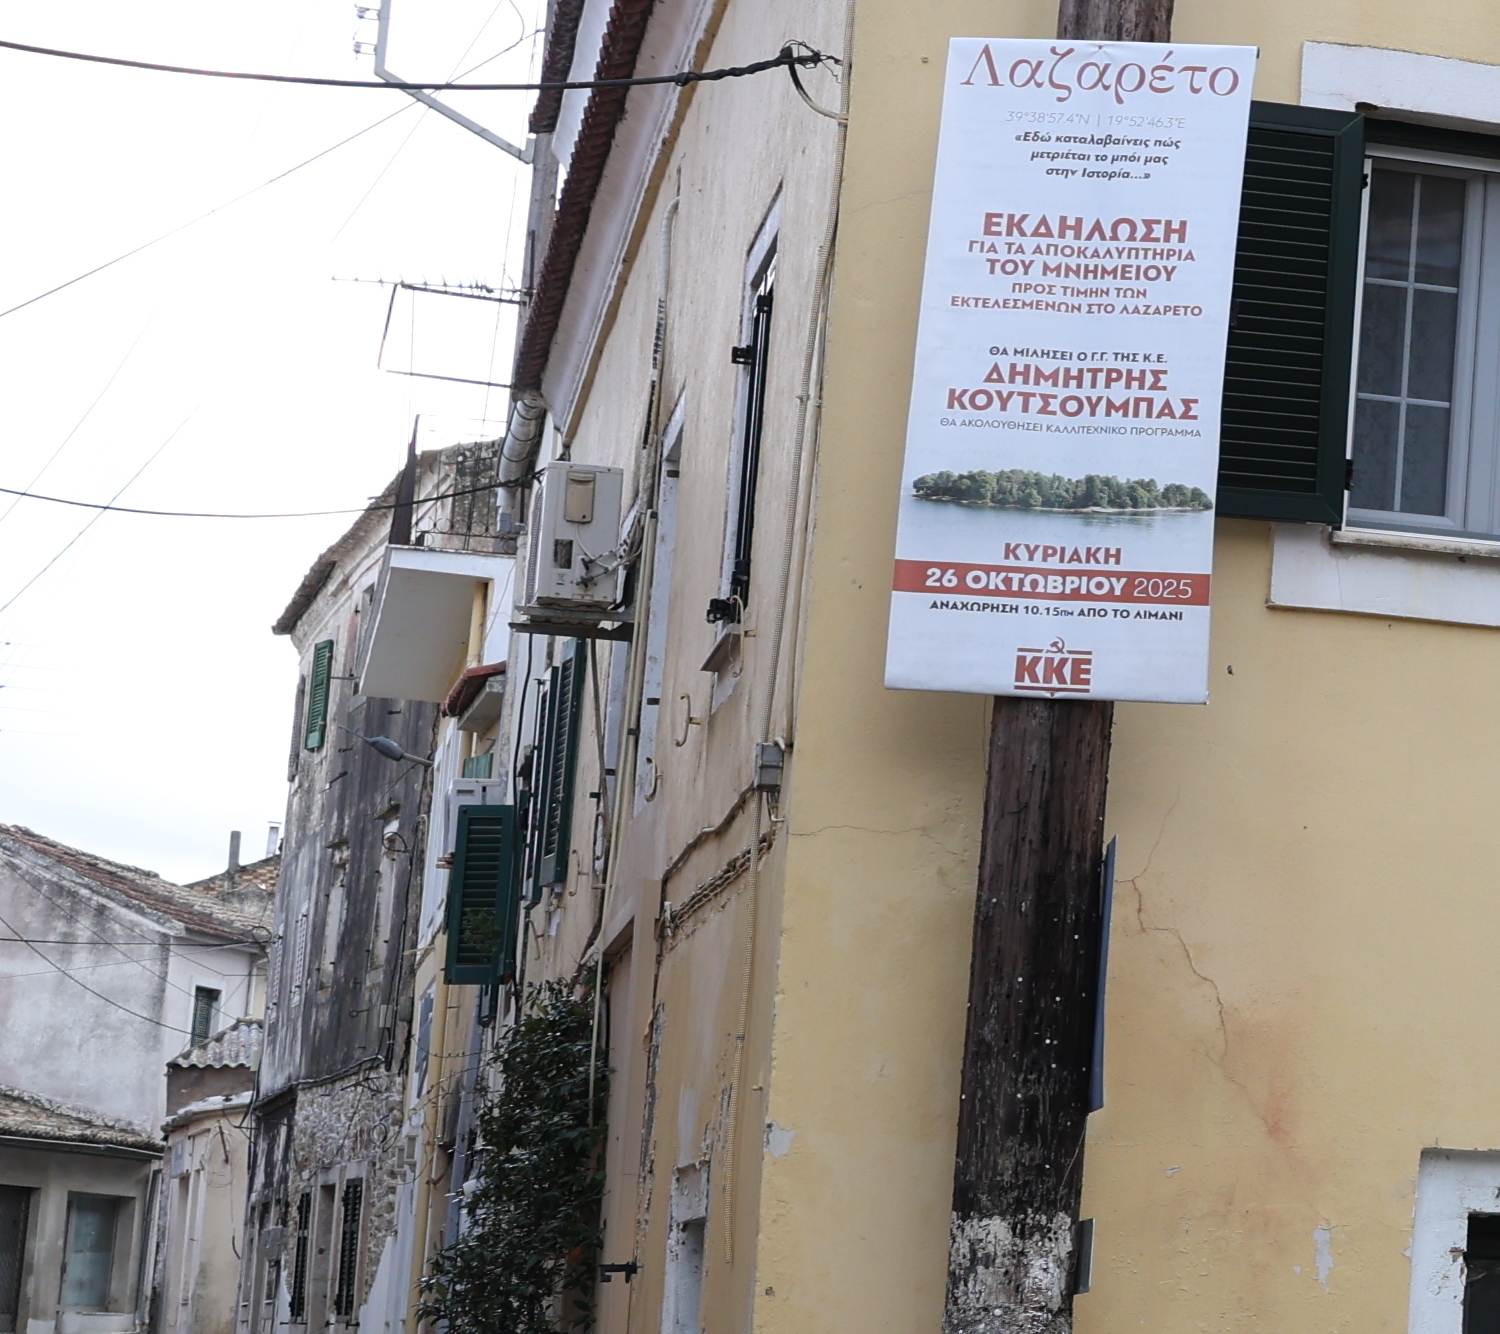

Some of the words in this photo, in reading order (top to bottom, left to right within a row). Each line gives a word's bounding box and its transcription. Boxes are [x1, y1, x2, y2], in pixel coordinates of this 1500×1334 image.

[959, 43, 1240, 106] Λαζαρέτο
[1014, 130, 1052, 143] «Εδώ
[1054, 133, 1151, 149] καταλαβαίνεις
[1153, 137, 1182, 150] πώς
[1029, 149, 1091, 162] μετριέται
[1094, 153, 1108, 162] το
[1110, 152, 1141, 165] μπόι
[1143, 154, 1170, 166] μας
[1045, 167, 1078, 179] στην
[983, 211, 1188, 244] ΕΚΔΗΛΩΣΗ
[968, 239, 999, 255] ΓΙΑ
[1003, 241, 1027, 256] ΤΑ
[1030, 241, 1196, 262] ΑΠΟΚΑΛΥΠΤΗΡΙΑ
[985, 258, 1035, 277] ΤΟΥ
[1041, 260, 1178, 283] ΜΝΗΜΕΙΟΥ
[1011, 282, 1057, 296] ΠΡΟΣ
[1060, 284, 1111, 299] ΤΙΜΗΝ
[1114, 286, 1148, 300] ΤΩΝ
[950, 295, 1082, 314] ΕΚΤΕΛΕΣΜΕΝΩΝ
[1085, 302, 1116, 315] ΣΤΟ
[1119, 303, 1203, 318] ΛΑΖΑΡΕΤΟ
[988, 346, 1010, 357] ΘΑ
[1012, 347, 1074, 362] ΜΙΛΗΣΕΙ
[1077, 350, 1088, 362] Ο
[1091, 350, 1109, 363] Γ.Γ.
[1112, 351, 1140, 364] ΤΗΣ
[1143, 352, 1168, 364] Κ.Ε.
[983, 361, 1169, 392] ΔΗΜΗΤΡΗΣ
[945, 387, 1200, 421] ΚΟΥΤΣΟΥΜΠΑΣ
[940, 416, 958, 428] ΘΑ
[959, 417, 1044, 433] ΑΚΟΛΟΥΘΗΣΕΙ
[1046, 423, 1128, 436] ΚΑΛΛΙΤΕΧΝΙΚΟ
[1130, 425, 1202, 438] ΠΡΟΓΡΑΜΜΑ
[1003, 542, 1122, 566] ΚΥΡΙΑΚΗ
[924, 567, 959, 588] 26
[965, 568, 1128, 596] ΟΚΤΩΒΡΙΟΥ
[1133, 577, 1193, 599] 2025
[929, 599, 1019, 615] ΑΝΑΧΩΡΗΣΗ
[1077, 607, 1108, 618] ΑΠΟ
[1111, 608, 1131, 619] ΤΟ
[1133, 609, 1184, 621] ΛΙΜΑΝΙ
[1014, 654, 1093, 687] ΚΚΕ
